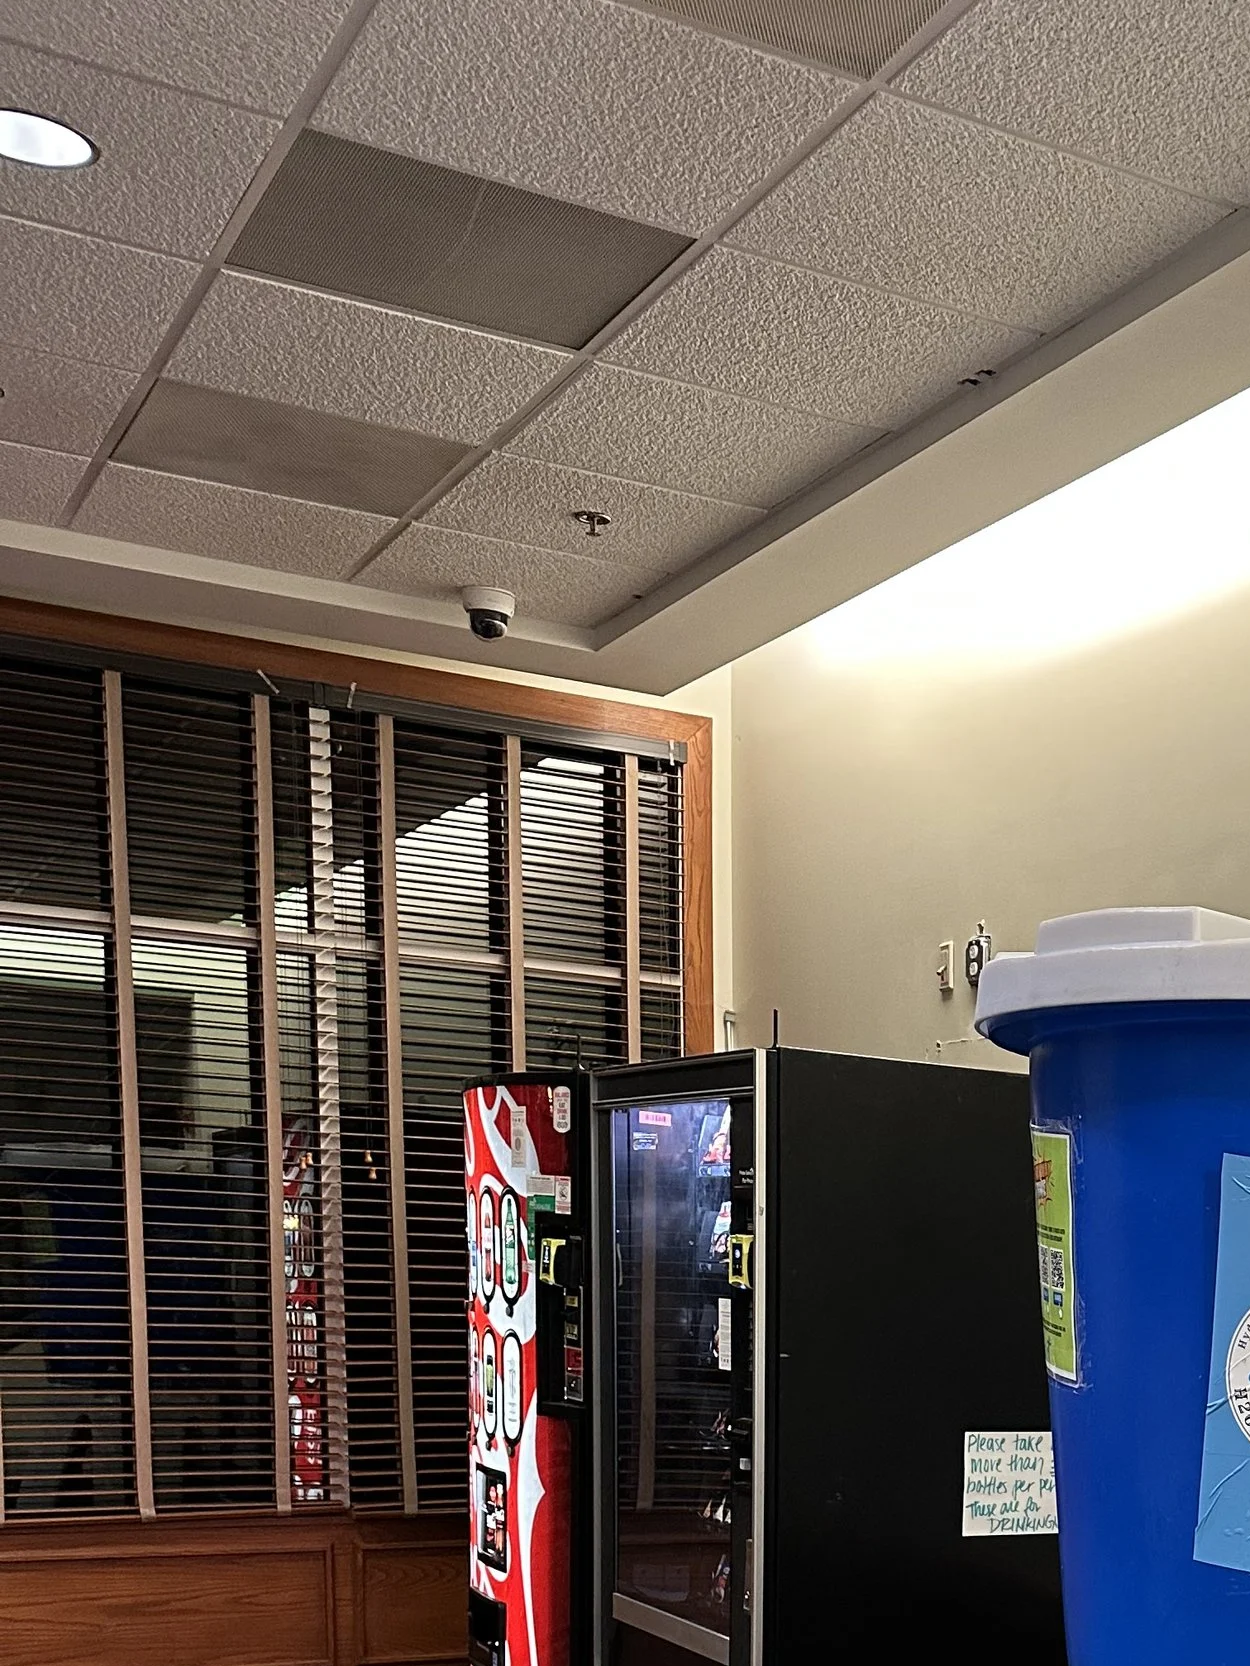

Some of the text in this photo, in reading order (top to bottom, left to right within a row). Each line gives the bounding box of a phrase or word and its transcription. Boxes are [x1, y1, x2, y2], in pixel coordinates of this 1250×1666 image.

[968, 1433, 1043, 1453] Please take
[1007, 1454, 1044, 1475] than
[966, 1476, 1007, 1496] bottles
[1012, 1479, 1035, 1500] per
[1024, 1496, 1041, 1517] for
